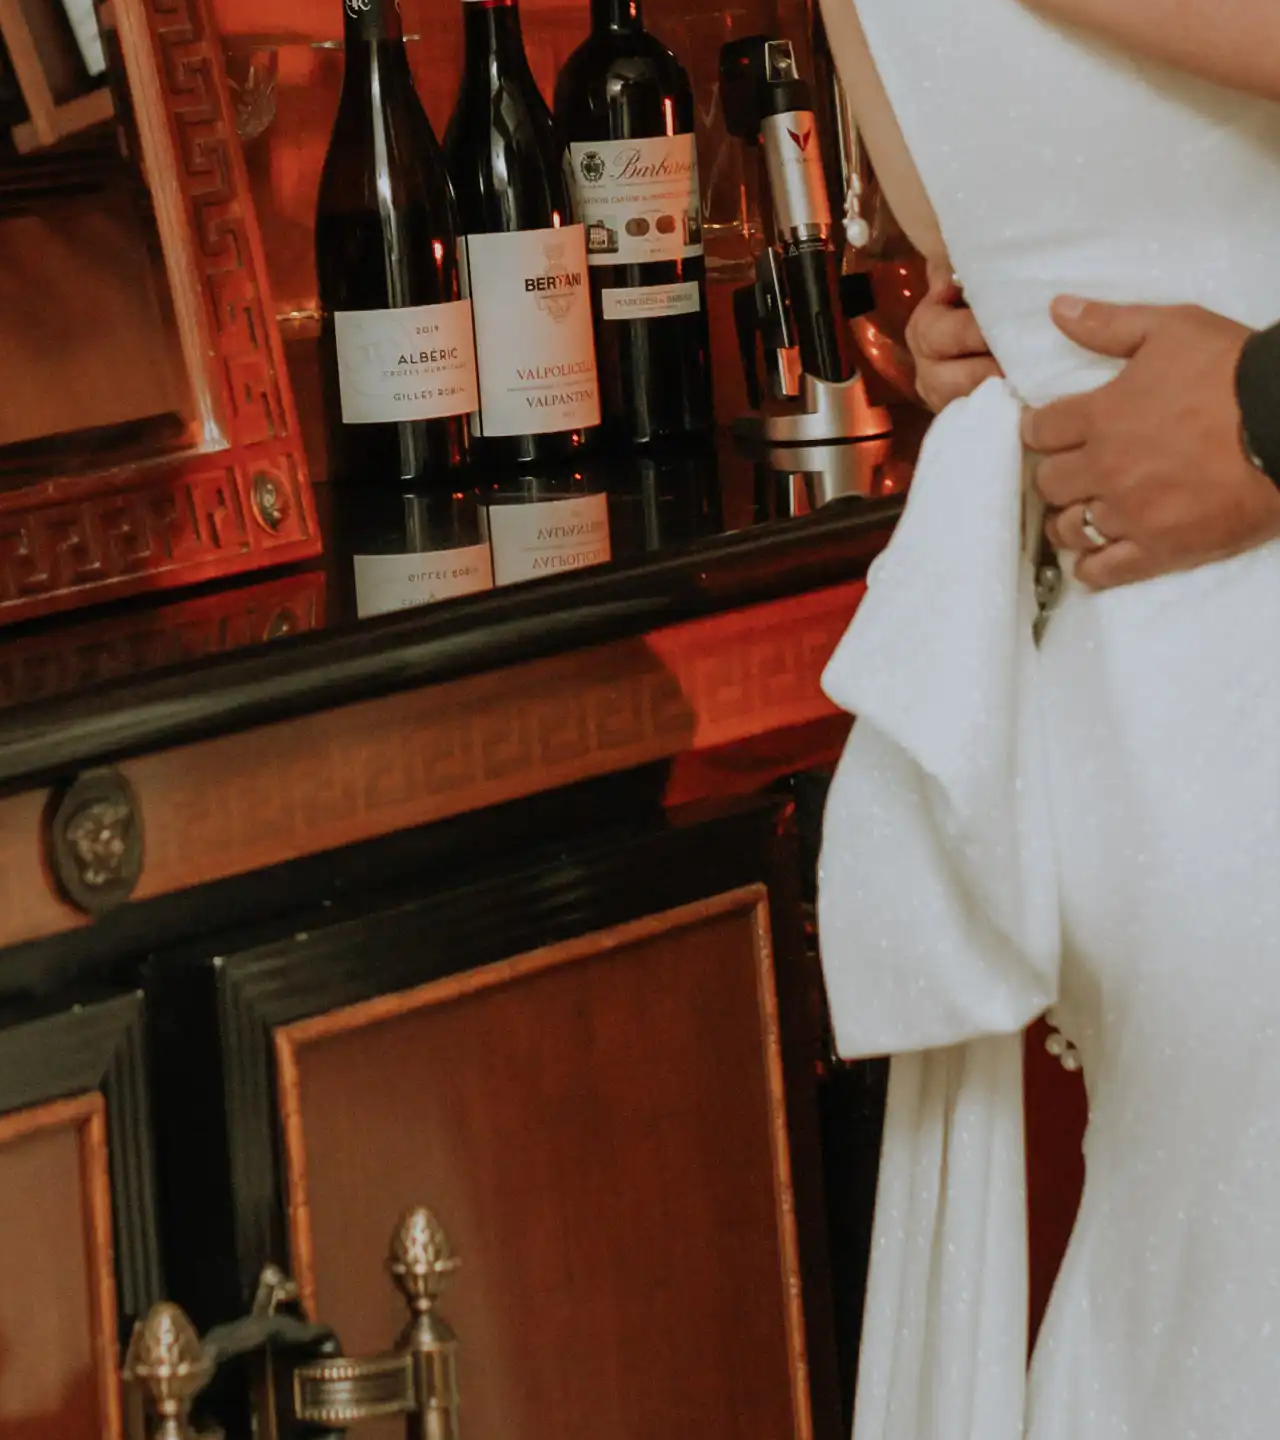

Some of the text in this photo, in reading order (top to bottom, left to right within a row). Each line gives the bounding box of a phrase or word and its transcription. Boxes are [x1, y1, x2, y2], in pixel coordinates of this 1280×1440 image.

[524, 271, 582, 293] BERTANI
[415, 324, 440, 335] 2019
[397, 347, 459, 366] ALBÉRIC
[393, 388, 434, 402] GILLES
